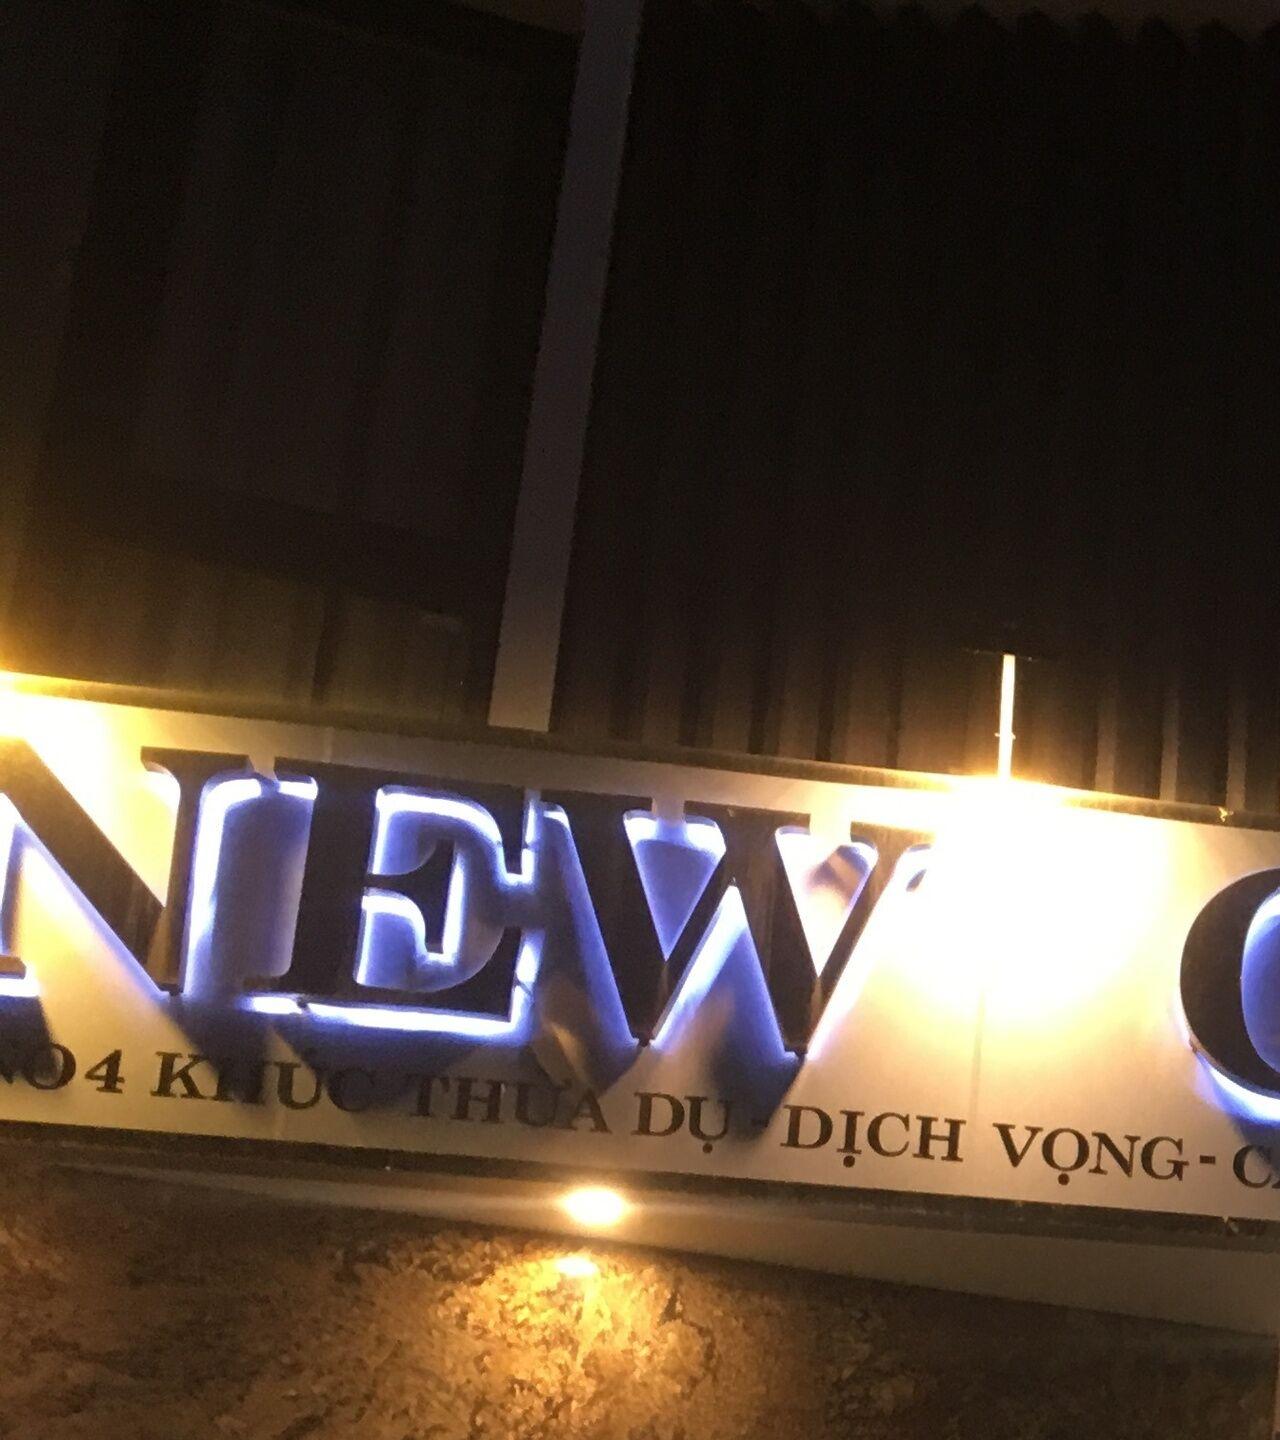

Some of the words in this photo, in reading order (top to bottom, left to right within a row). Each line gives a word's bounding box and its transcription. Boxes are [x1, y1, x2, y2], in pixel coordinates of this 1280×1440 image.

[0, 736, 940, 1058] NEW
[630, 1091, 730, 1153] DỤ
[780, 1104, 966, 1168] DỊCH
